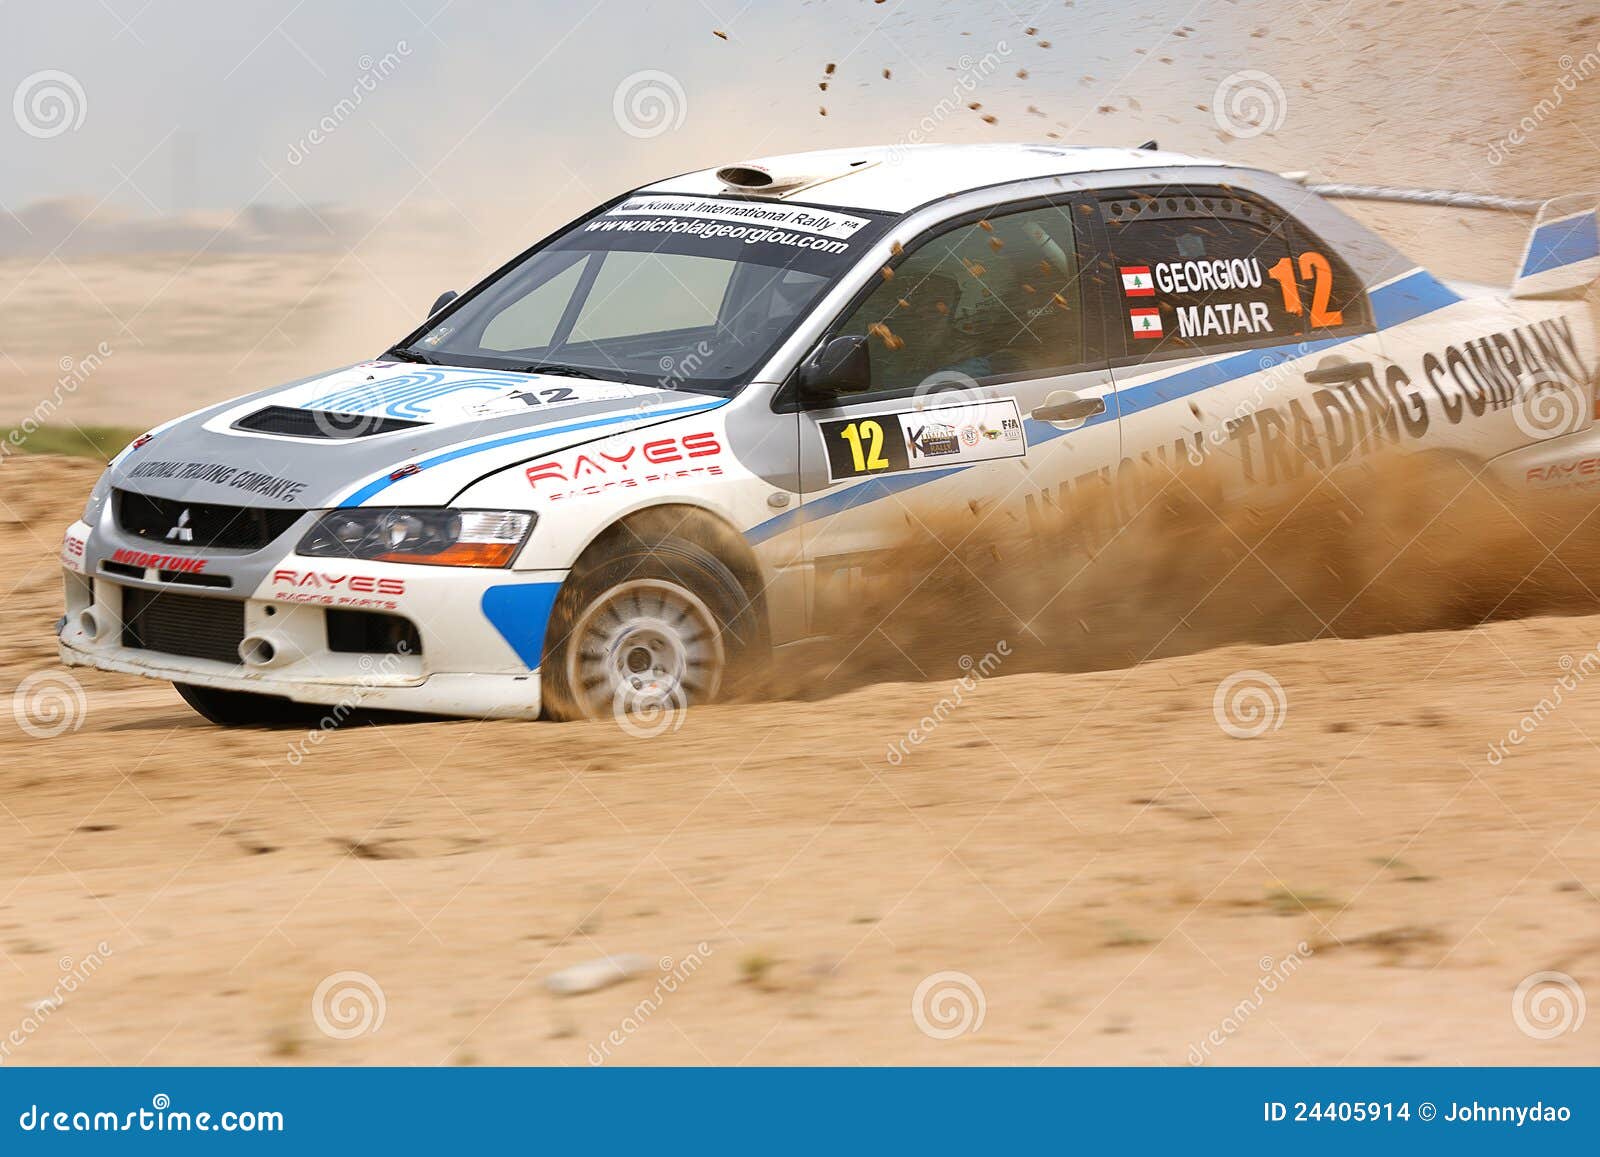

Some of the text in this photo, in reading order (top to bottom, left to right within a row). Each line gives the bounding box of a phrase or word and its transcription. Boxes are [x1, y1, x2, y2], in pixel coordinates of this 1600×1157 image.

[643, 200, 695, 212] Kuwait
[693, 202, 792, 222] International
[791, 213, 836, 232] Rally
[584, 217, 849, 255] www.nicholaigeorgiou.com
[1155, 257, 1262, 294] GEORGIOU
[1268, 251, 1344, 329] 12
[1176, 301, 1274, 338] MATAR
[509, 387, 580, 406] 12
[525, 431, 721, 489] RAYES
[841, 420, 889, 472] 12
[177, 462, 237, 484] TRADING
[1525, 458, 1600, 484] RAYE
[111, 548, 208, 574] MOTORTUNE
[273, 569, 405, 595] RAYES
